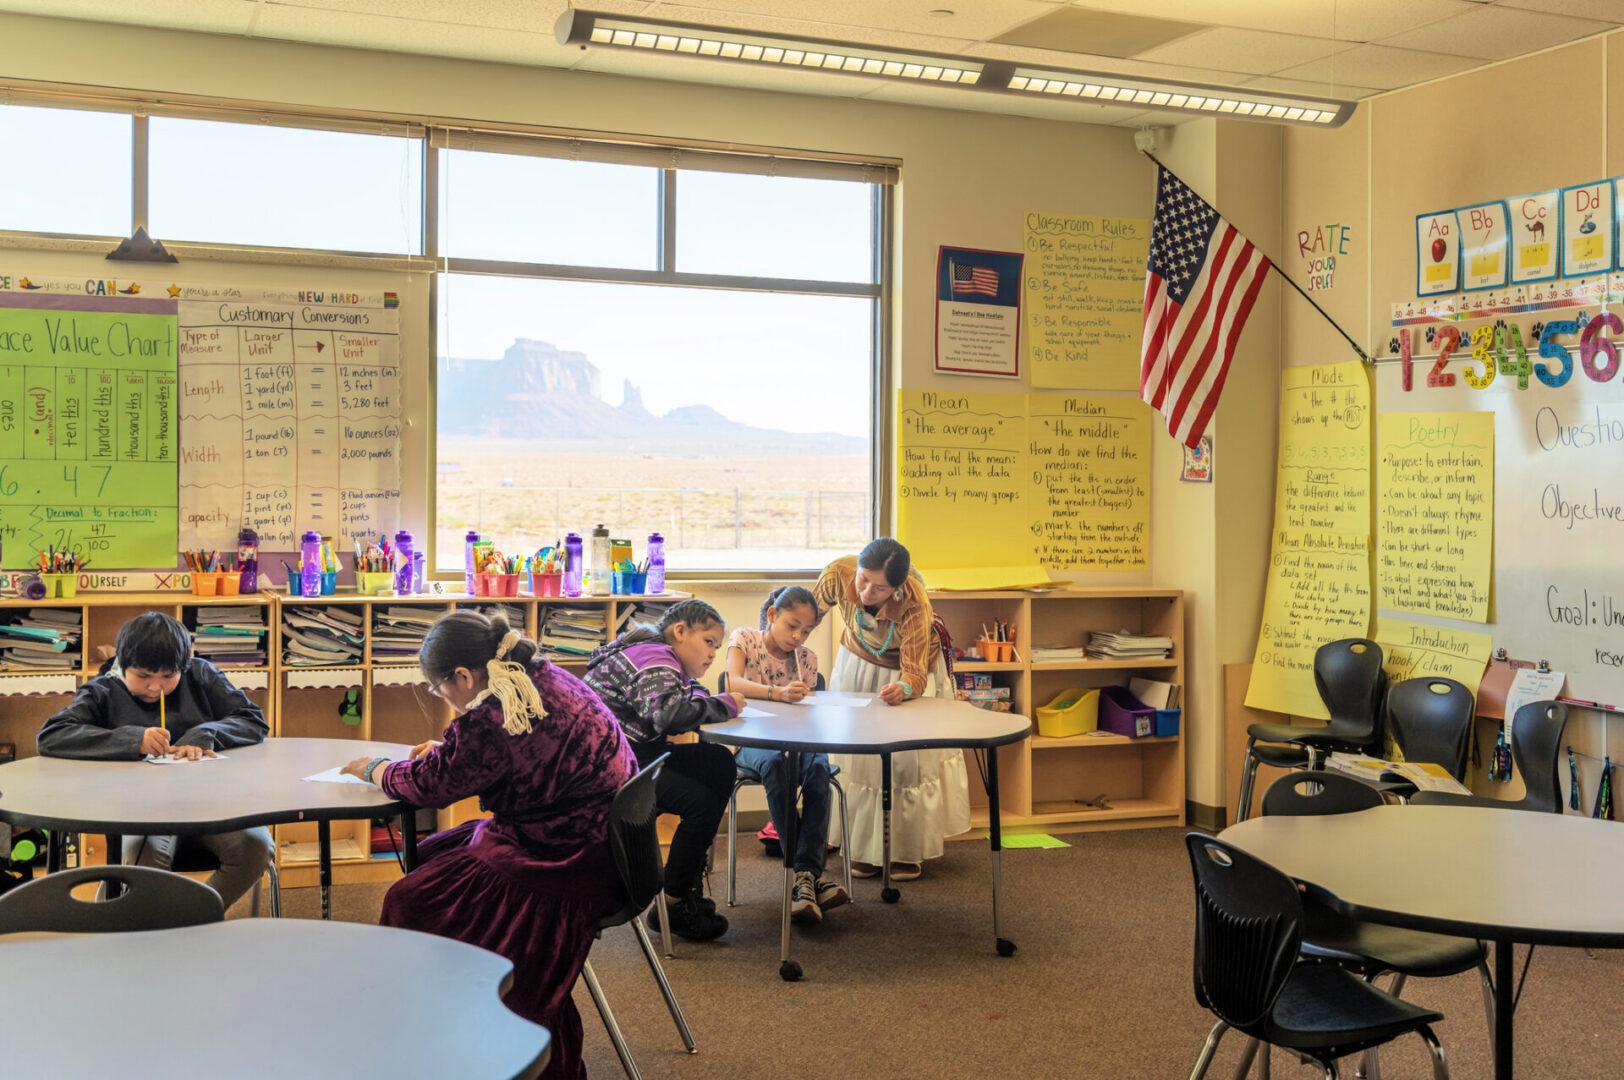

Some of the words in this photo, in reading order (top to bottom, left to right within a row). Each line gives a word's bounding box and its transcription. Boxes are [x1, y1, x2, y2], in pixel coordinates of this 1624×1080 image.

[1576, 187, 1600, 212] Dd
[1522, 198, 1546, 220] Cc
[1027, 213, 1094, 232] Classroom
[1102, 219, 1136, 236] Rules
[1470, 208, 1494, 230] Bb
[1429, 218, 1448, 238] Aa
[1040, 239, 1053, 251] Be
[1060, 239, 1114, 252] Respectful
[1298, 224, 1350, 258] RATE
[85, 280, 117, 296] CAN
[1043, 280, 1058, 292] Be
[1062, 280, 1088, 292] Safe
[298, 291, 324, 303] NEW
[331, 293, 358, 304] HARD
[1547, 290, 1558, 299] -39
[219, 304, 294, 324] Customary
[302, 307, 370, 325] Conversions
[1044, 316, 1056, 326] Be
[1061, 315, 1112, 328] Responsible
[45, 318, 101, 356] Value
[108, 322, 174, 356] Chart
[184, 329, 208, 345] Type
[210, 329, 220, 340] of
[244, 329, 284, 345] Larger
[340, 335, 380, 346] Smaller
[180, 344, 222, 354] Measure
[248, 344, 274, 356] Unit
[343, 348, 364, 358] Unit
[1045, 348, 1058, 361] Be
[1065, 348, 1088, 361] Kind
[1400, 329, 1412, 392] 1
[1427, 326, 1459, 388] 2
[1463, 325, 1496, 390] 3
[1495, 324, 1532, 390] 4
[1534, 320, 1578, 388] 5
[1580, 312, 1622, 382] 6
[243, 368, 252, 380] 1
[256, 367, 274, 380] foot
[276, 364, 294, 378] (ft)
[340, 367, 349, 377] 12
[352, 368, 378, 377] inches
[382, 367, 397, 377] (in)
[1312, 366, 1344, 385] Mode
[184, 379, 224, 404] Length
[244, 383, 253, 394] 1
[256, 382, 275, 396] yard
[276, 380, 294, 395] (yd)
[344, 380, 351, 392] 3
[355, 380, 372, 391] feet
[246, 400, 254, 410] 1
[258, 400, 275, 410] mile
[278, 398, 294, 410] (mi)
[342, 397, 370, 410] 5,280
[374, 396, 389, 408] feet
[922, 392, 968, 410] Mean
[1064, 399, 1106, 414] Median
[245, 429, 254, 440] 1
[256, 430, 278, 442] pound
[280, 426, 294, 439] (lb)
[344, 426, 354, 438] 16
[355, 430, 383, 440] ounces
[384, 425, 400, 438] (oz)
[1409, 416, 1459, 448] Poetry
[182, 444, 222, 464] Width
[246, 449, 252, 458] 1
[256, 449, 270, 457] ton
[274, 446, 288, 456] (T)
[342, 448, 366, 460] 2,000
[369, 449, 392, 460] pounds
[906, 449, 925, 462] How
[932, 449, 940, 462] to
[944, 450, 960, 464] find
[968, 451, 981, 464] the
[986, 456, 1016, 464] mean:
[1030, 441, 1052, 456] How
[1058, 443, 1070, 456] do
[1078, 448, 1090, 458] we
[1096, 444, 1115, 460] find
[1122, 446, 1138, 460] the
[1046, 459, 1088, 470] median:
[1388, 453, 1422, 470] Purpose:
[1426, 452, 1434, 468] to
[0, 465, 18, 496] 6
[64, 466, 78, 498] 4
[90, 466, 112, 498] 7
[909, 464, 942, 485] adding
[948, 466, 960, 476] all
[968, 466, 981, 477] the
[988, 466, 1010, 478] data
[1306, 470, 1335, 484] Range
[246, 491, 252, 500] 1
[256, 492, 270, 502] cup
[274, 490, 288, 499] (c)
[913, 486, 938, 497] Divide
[946, 486, 957, 502] by
[964, 489, 988, 502] many
[992, 492, 1020, 504] groups
[1389, 488, 1404, 498] Can
[1408, 488, 1416, 498] be
[1421, 488, 1442, 499] about
[1446, 491, 1461, 504] any
[1466, 489, 1484, 504] topic
[46, 507, 82, 518] Decimal
[94, 507, 102, 517] to
[108, 508, 158, 518] Fraction:
[246, 502, 252, 512] 1
[254, 504, 272, 514] pint
[276, 502, 292, 512] (pt)
[91, 524, 106, 535] 47
[244, 517, 250, 526] 1
[254, 516, 275, 529] quart
[278, 516, 292, 526] (qt)
[342, 528, 348, 538] 4
[350, 528, 376, 540] quarts
[88, 540, 110, 552] 100
[80, 574, 127, 588] OURSELF
[1547, 585, 1596, 626] Goal:
[1603, 595, 1624, 627] Un
[1409, 626, 1470, 654] Introduction
